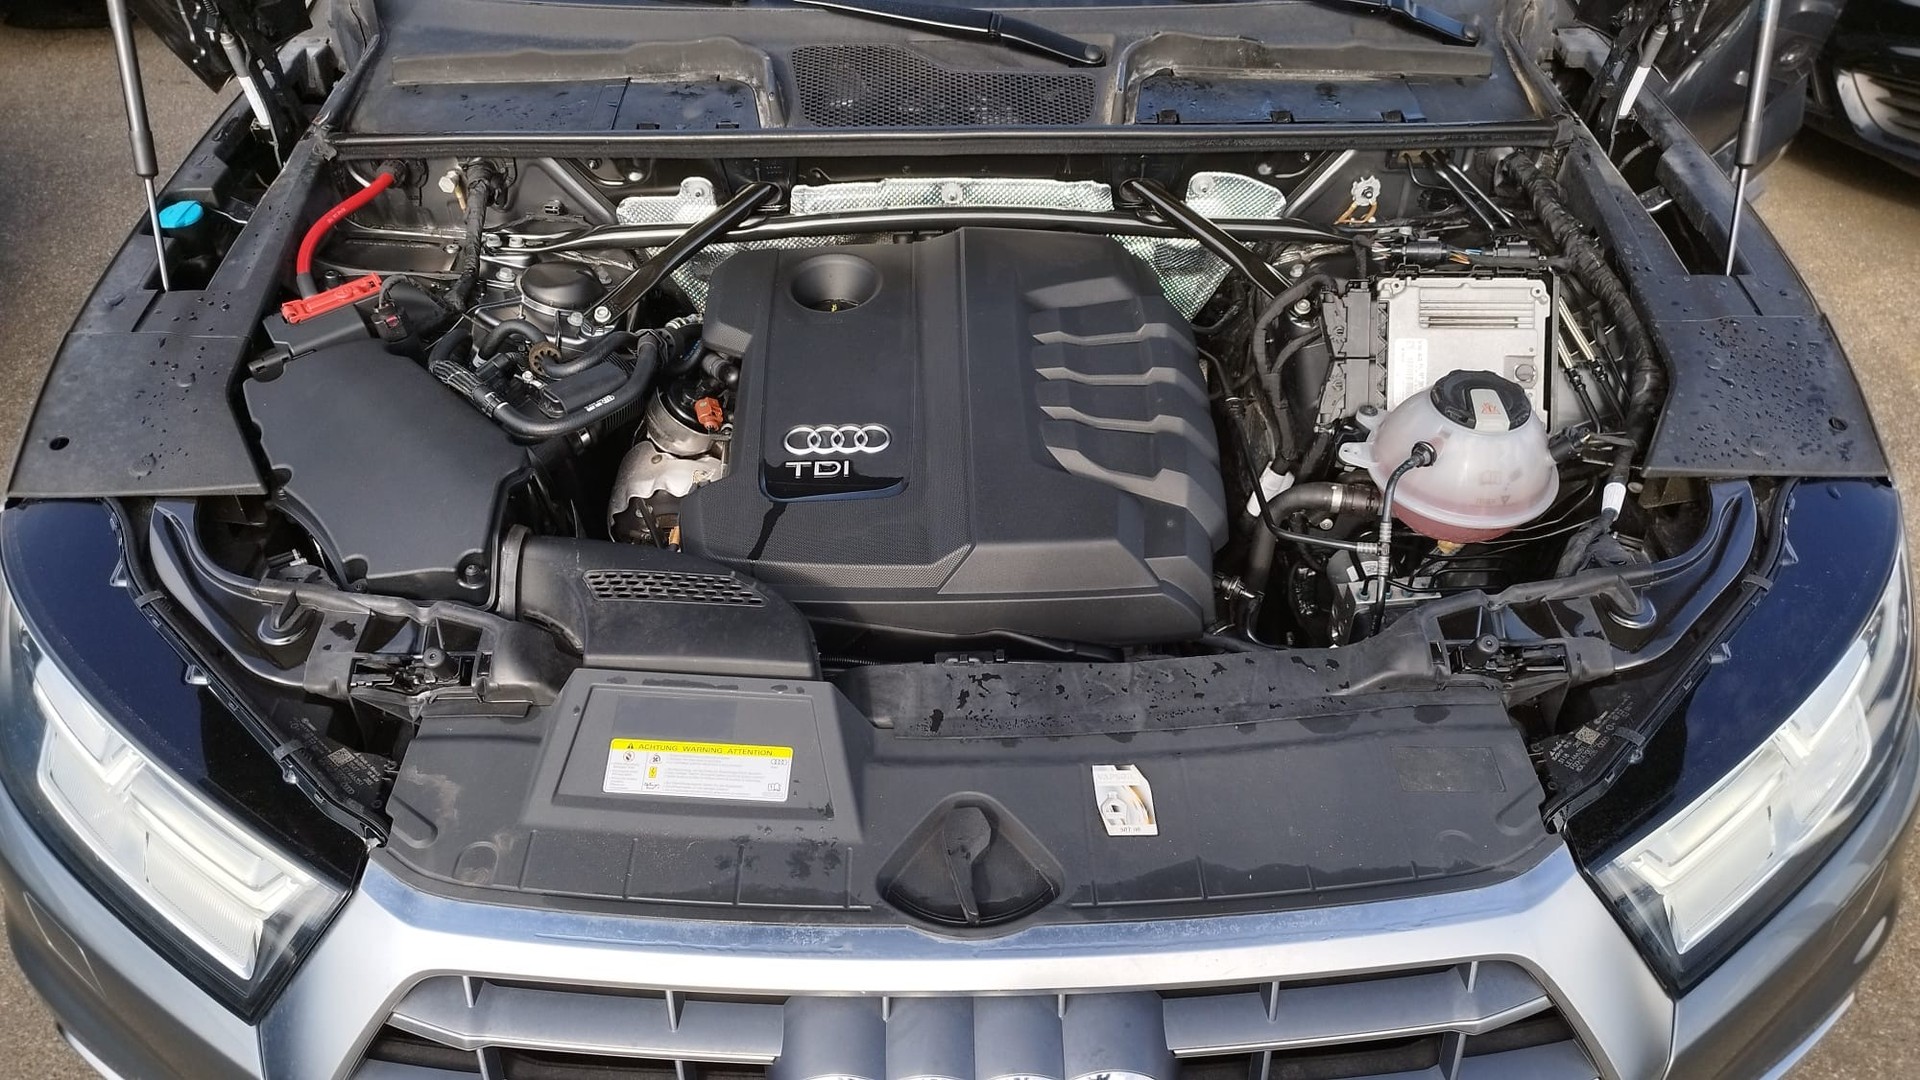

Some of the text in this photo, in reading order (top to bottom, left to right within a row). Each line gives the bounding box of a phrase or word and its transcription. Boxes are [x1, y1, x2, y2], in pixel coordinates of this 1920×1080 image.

[785, 460, 850, 479] TDI
[638, 743, 773, 756] ACHTUNG WARNING ATTENTION
